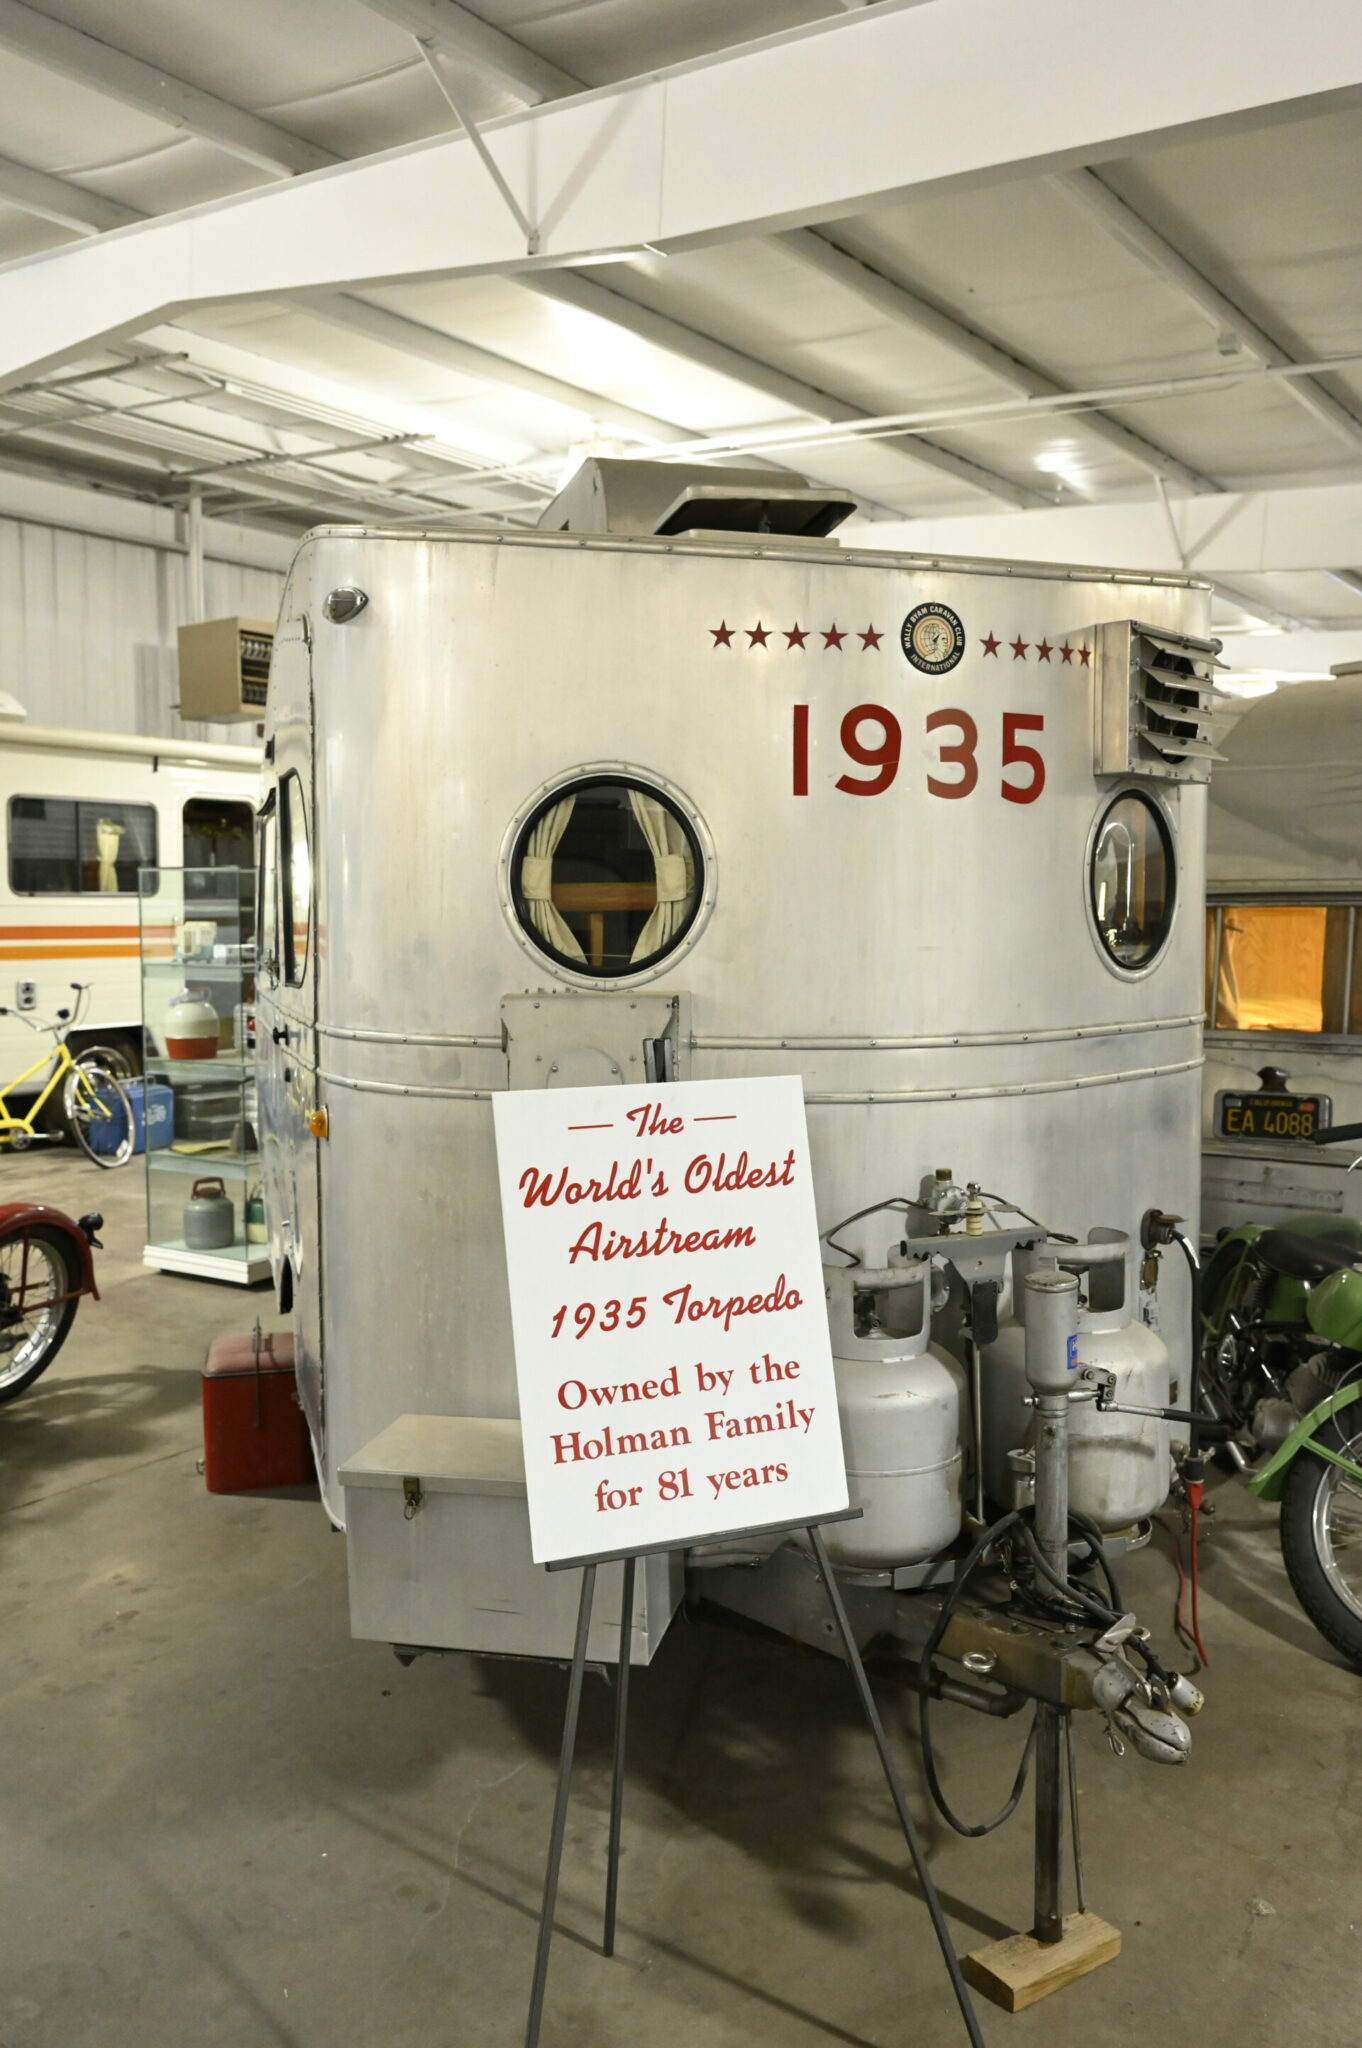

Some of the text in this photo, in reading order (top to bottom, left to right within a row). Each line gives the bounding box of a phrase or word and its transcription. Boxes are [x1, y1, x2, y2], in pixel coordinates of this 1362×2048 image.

[903, 605, 963, 649] WALLY BYAM CARAVAN CLUB
[910, 651, 960, 671] INTERNATIONAL
[792, 703, 1046, 805] 1935
[625, 1102, 685, 1137] The
[1226, 1108, 1314, 1136] EA 4088
[518, 1149, 796, 1209] World's Oldest
[568, 1217, 757, 1264] Airstream
[551, 1273, 804, 1340] 1935 Torpedo
[557, 1353, 801, 1410] Owned by the
[550, 1399, 816, 1465] Holman Family
[594, 1462, 789, 1513] for 81 years
